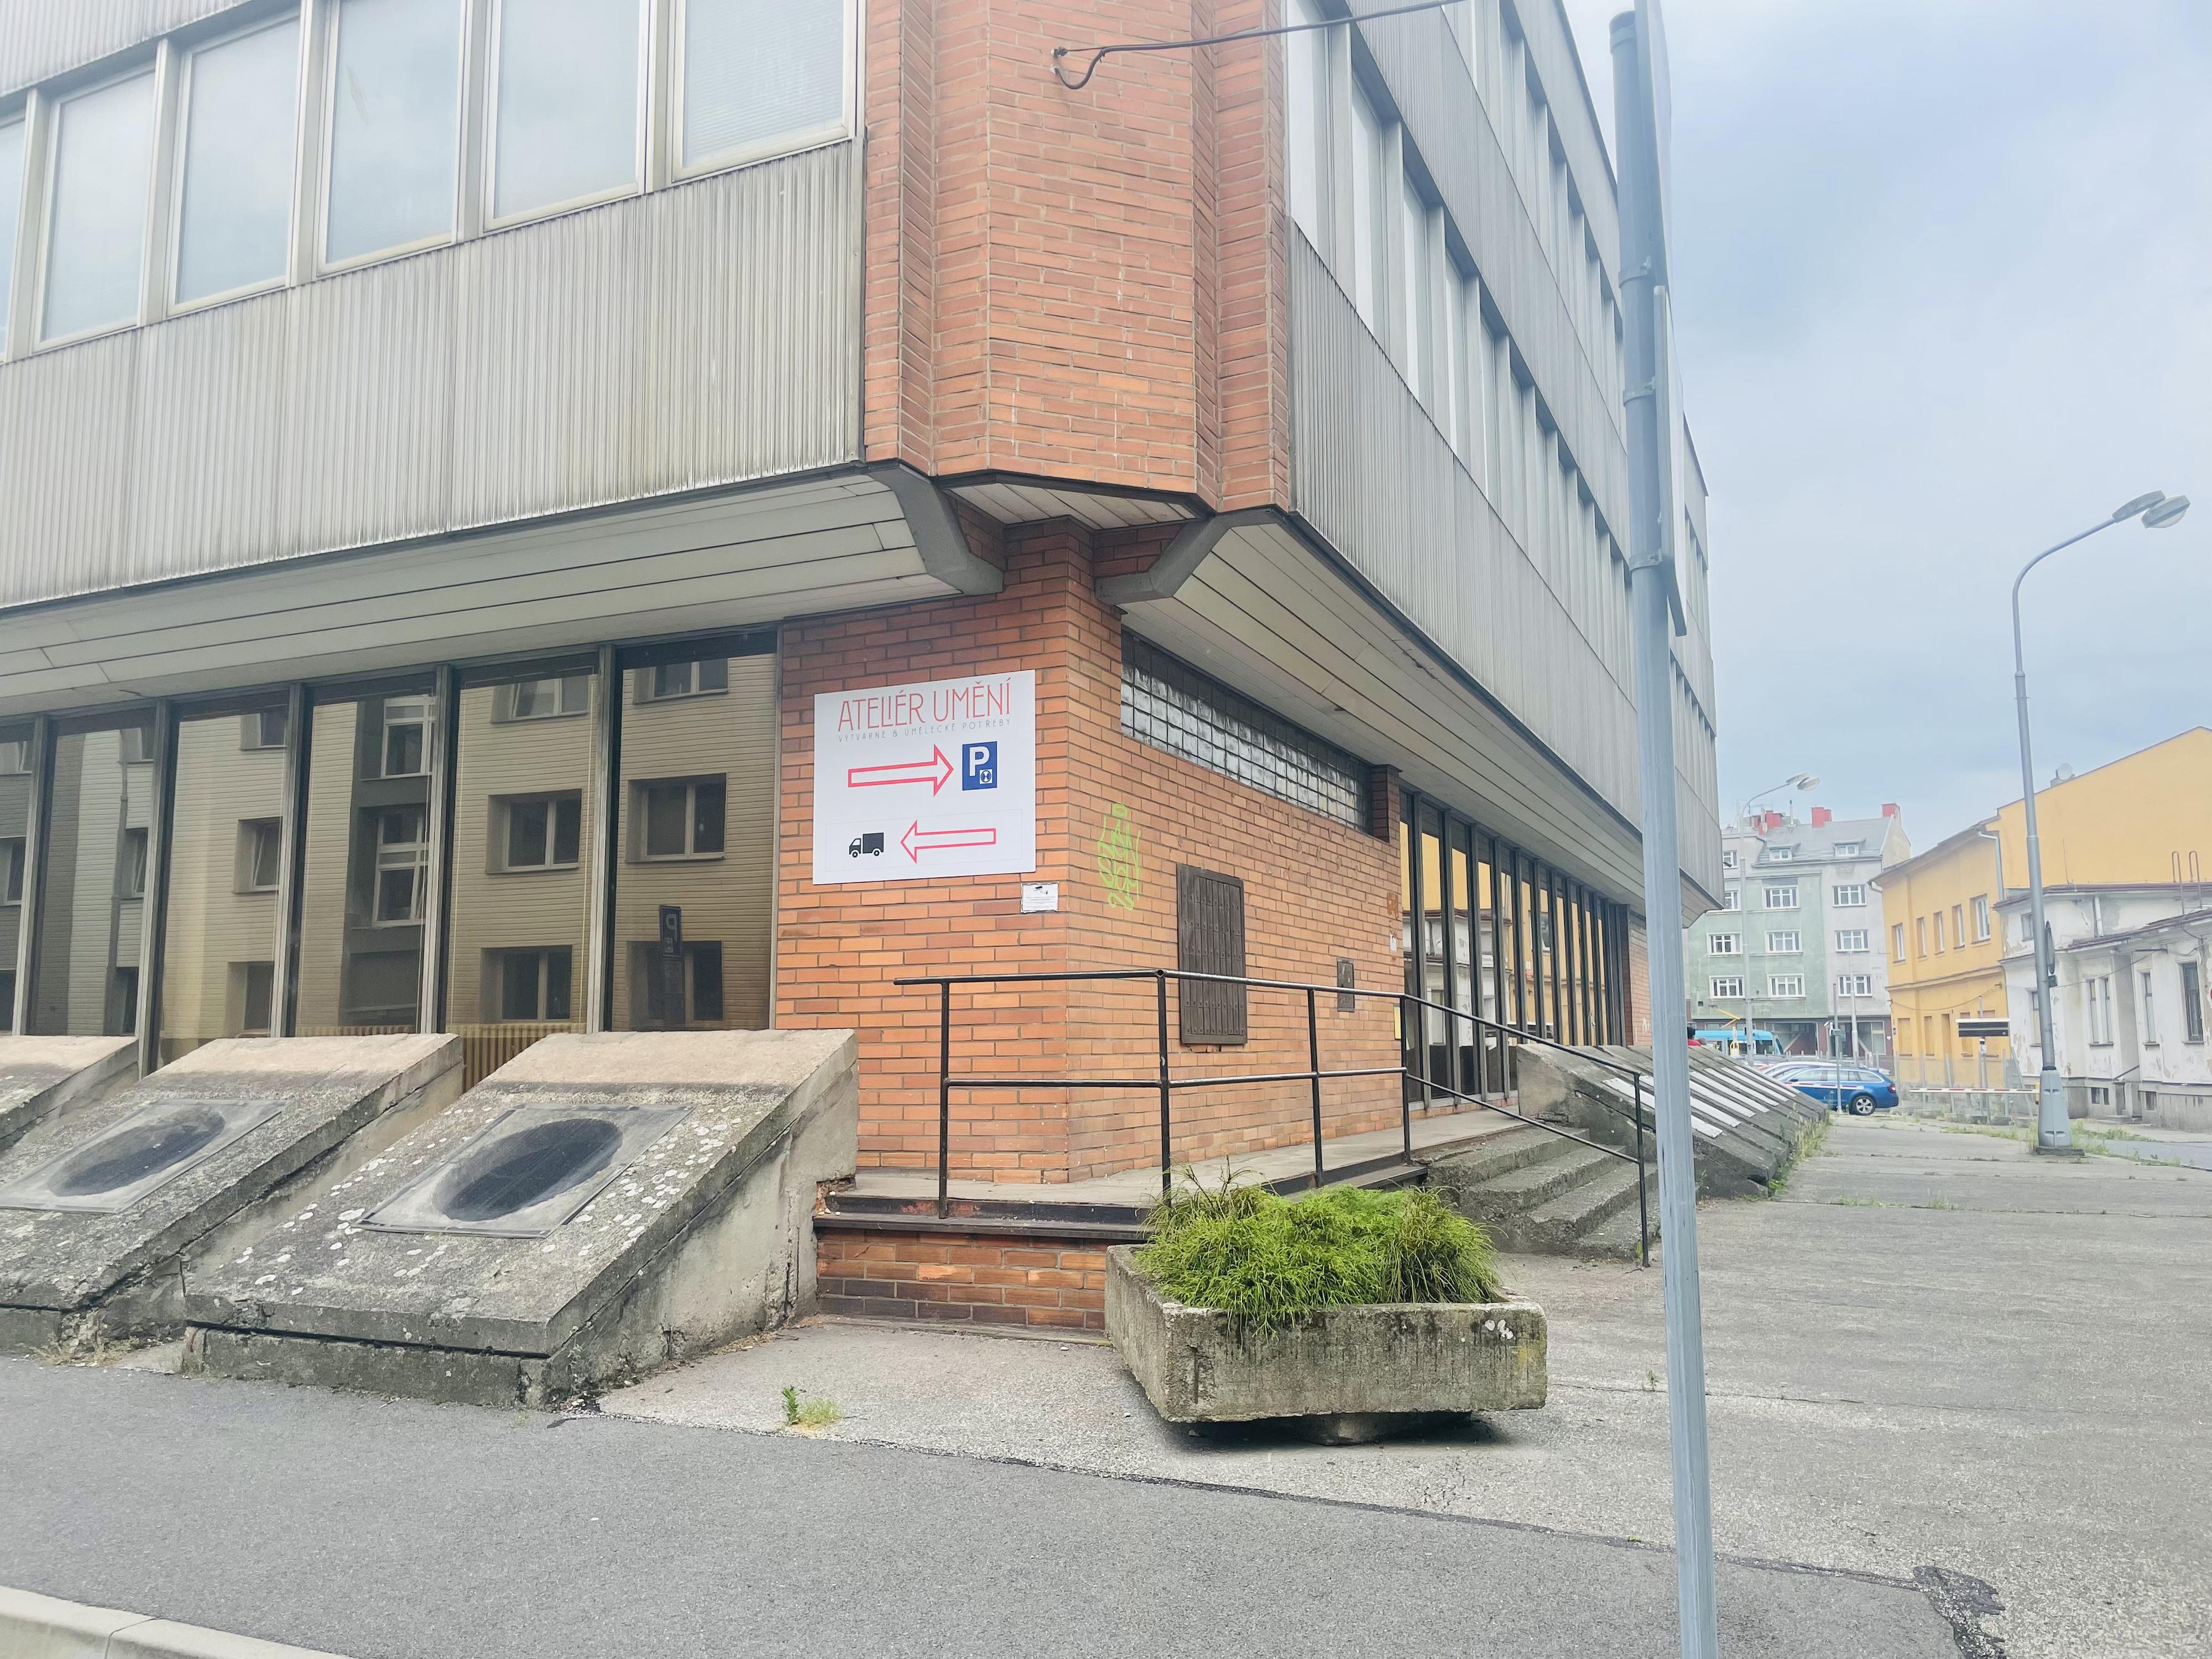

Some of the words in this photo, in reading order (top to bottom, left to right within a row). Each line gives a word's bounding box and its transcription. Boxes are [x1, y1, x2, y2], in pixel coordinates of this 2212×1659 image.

[838, 689, 926, 732] ATELIÉR
[933, 677, 1011, 722] UMĚNÍ
[969, 746, 990, 776] P
